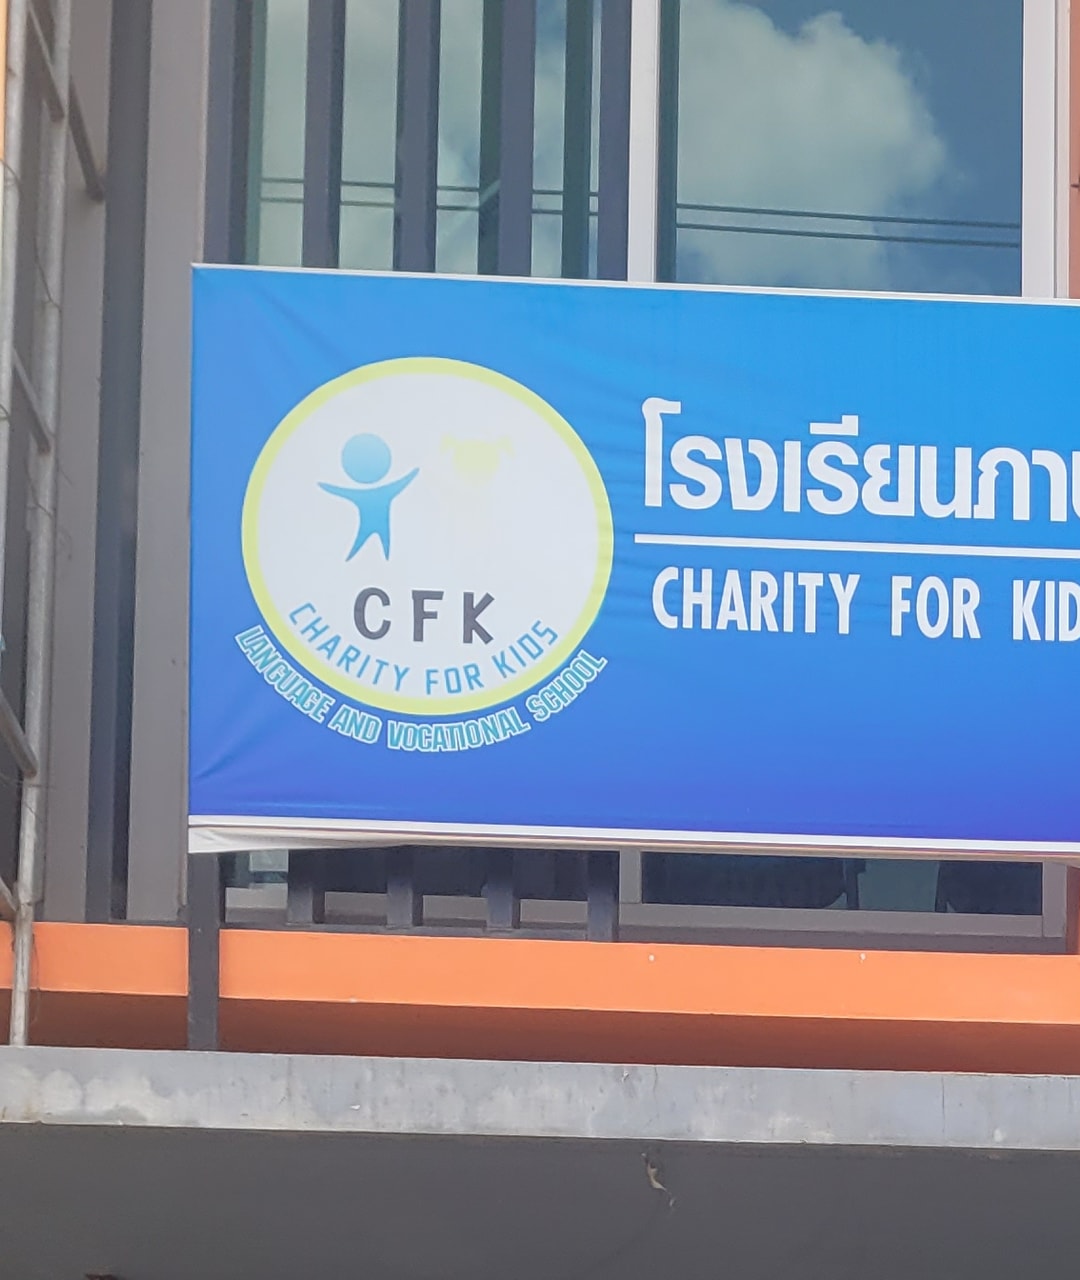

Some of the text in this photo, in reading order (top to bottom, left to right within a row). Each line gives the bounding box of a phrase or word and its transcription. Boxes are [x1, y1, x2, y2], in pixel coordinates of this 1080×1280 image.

[353, 586, 496, 646] CFK
[652, 566, 860, 635] CHARITY
[891, 575, 981, 640] FOR
[234, 625, 608, 753] LANGUAGE AND VOCATIONAL SCHOOL
[288, 602, 559, 695] CHARITY FOR KIDS
